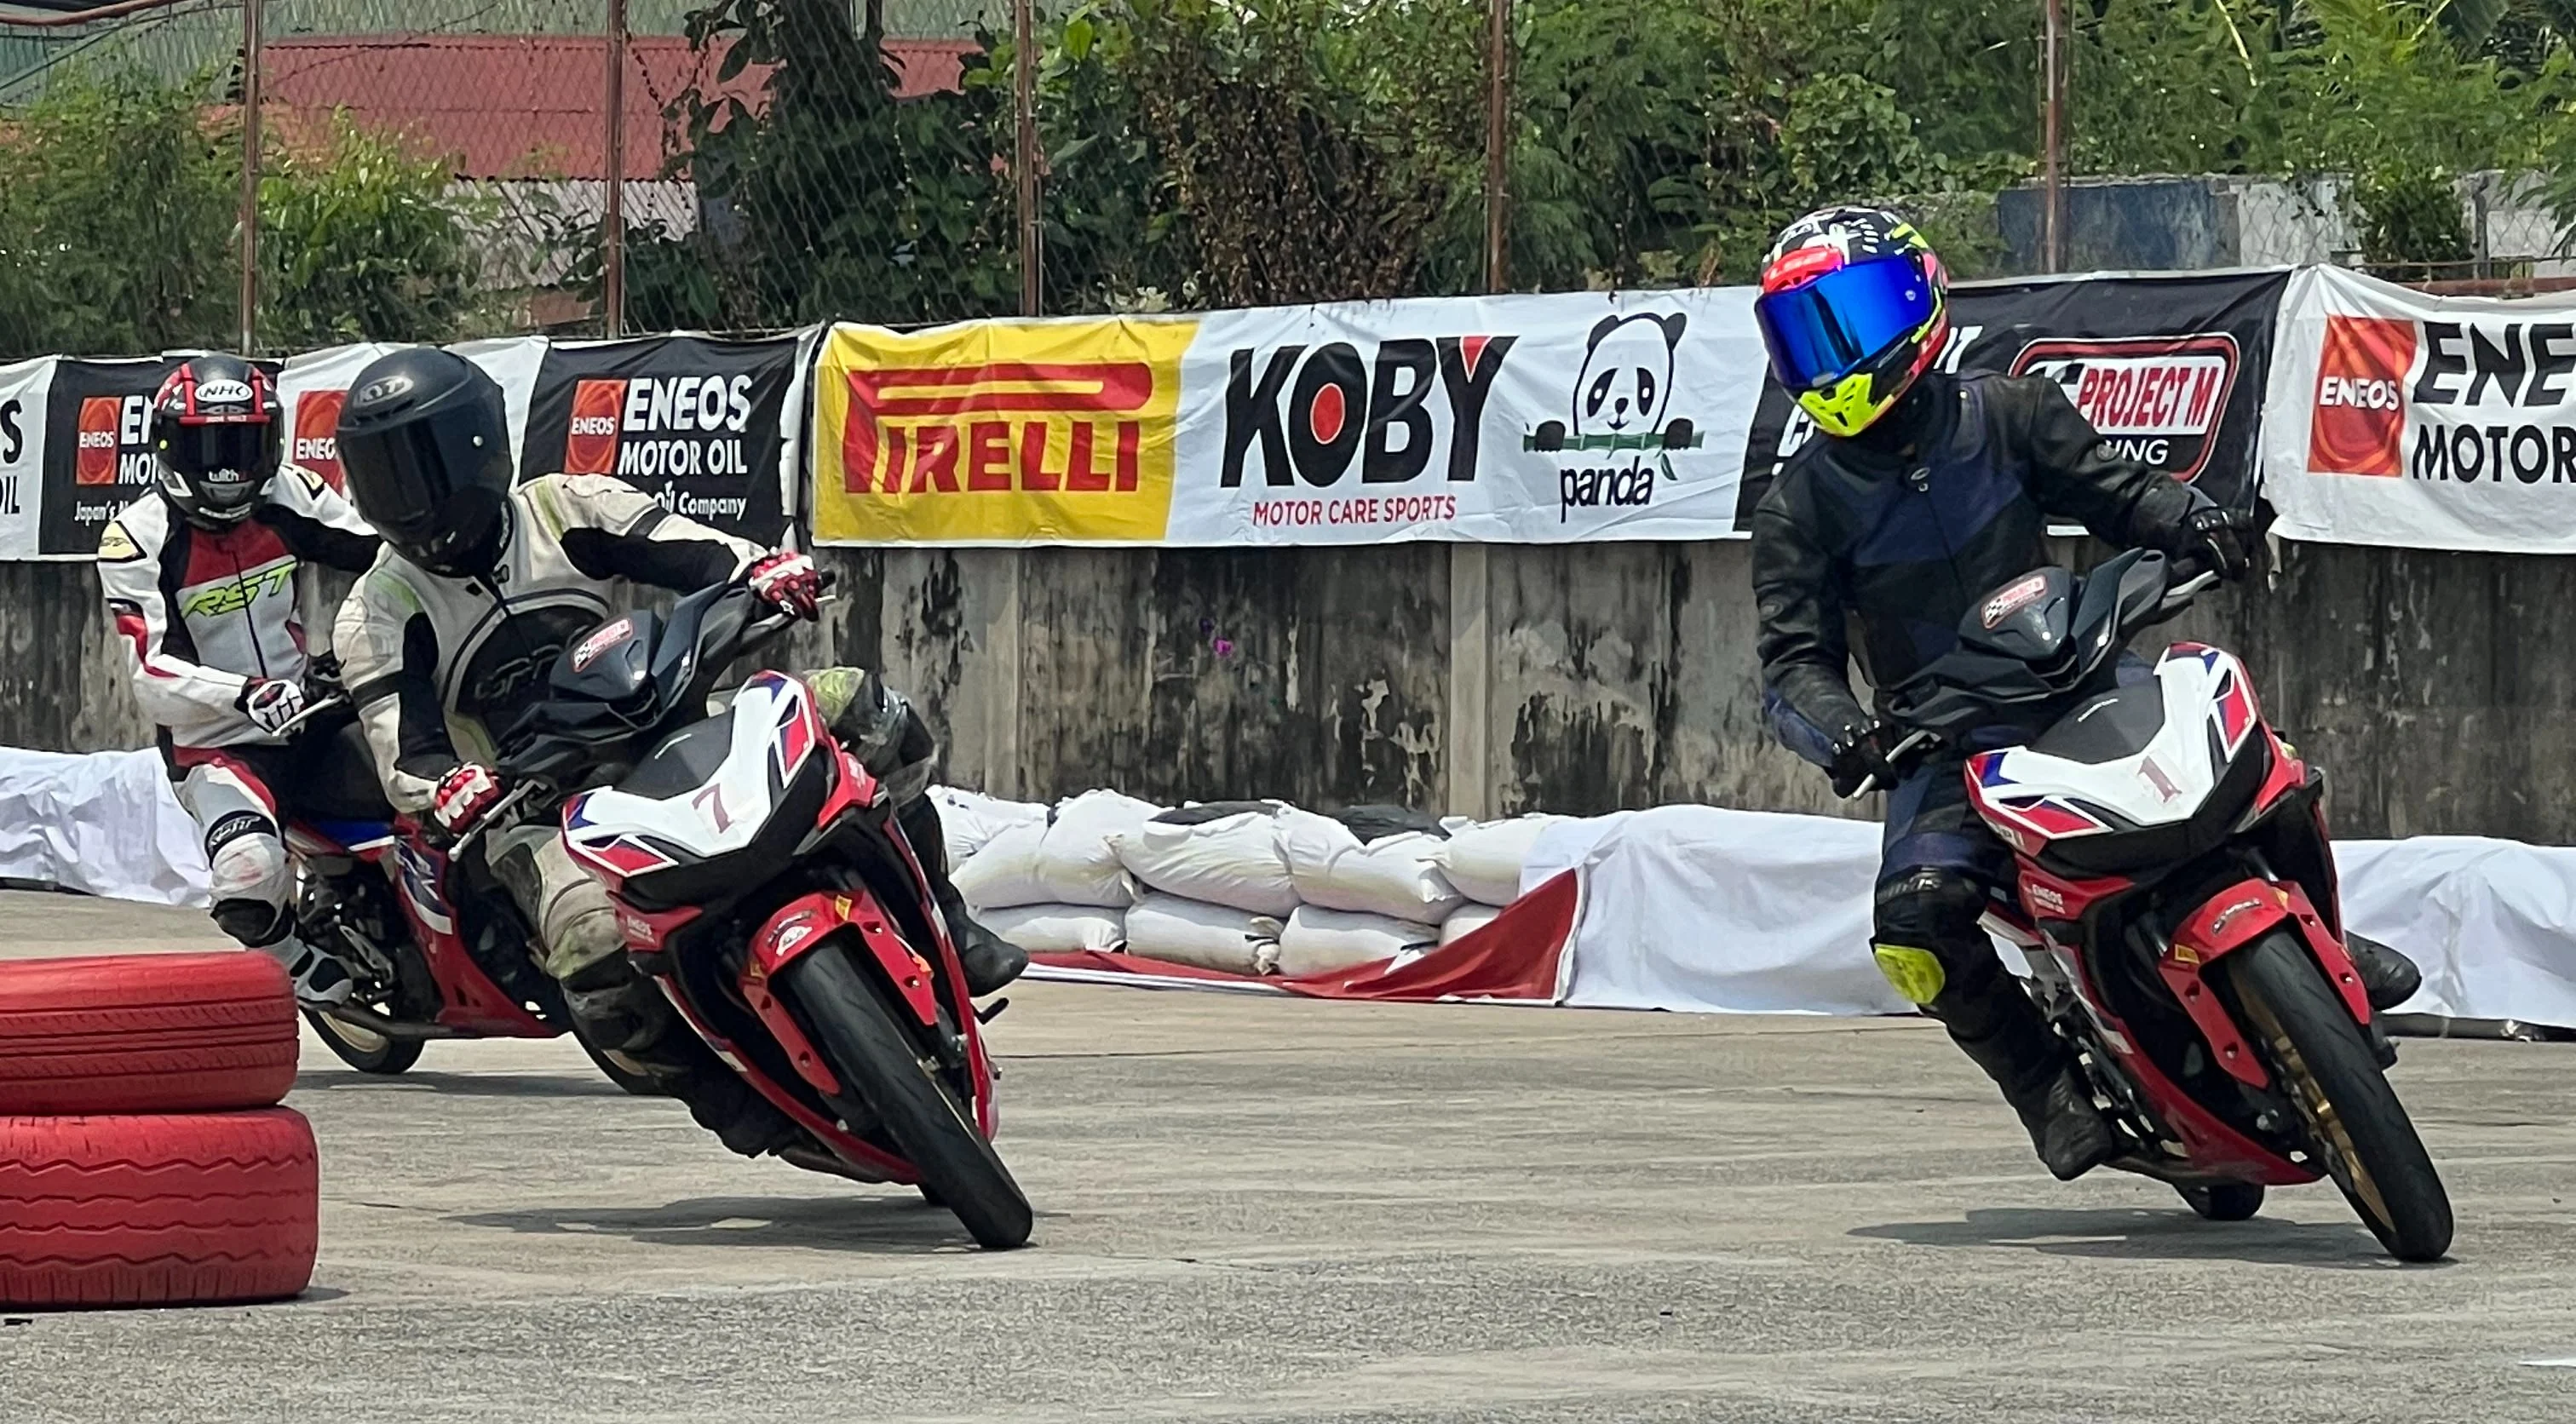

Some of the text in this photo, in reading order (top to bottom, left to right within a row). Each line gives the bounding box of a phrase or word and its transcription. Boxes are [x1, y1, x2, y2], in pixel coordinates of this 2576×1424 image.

[2412, 321, 2576, 408] ENE
[623, 375, 752, 433] ENEOS
[1221, 335, 1520, 488] KOBY
[2078, 366, 2219, 427] PROJECT M
[2319, 376, 2400, 411] ENEOS
[80, 431, 115, 448] ENEOS
[571, 416, 616, 435] ENEOS
[843, 362, 1153, 494] PIRELLI
[296, 437, 336, 460] ENEO
[617, 439, 748, 476] MOTOR OIL
[2113, 439, 2170, 465] ING
[2412, 424, 2576, 484] MOTOR
[118, 453, 157, 485] MOT
[0, 476, 20, 514] IL
[678, 491, 747, 521] Company
[1560, 456, 1655, 524] panda
[1253, 496, 1456, 525] MOTOR CARE SPORTS
[2137, 755, 2182, 804] 1
[692, 783, 734, 834] 7
